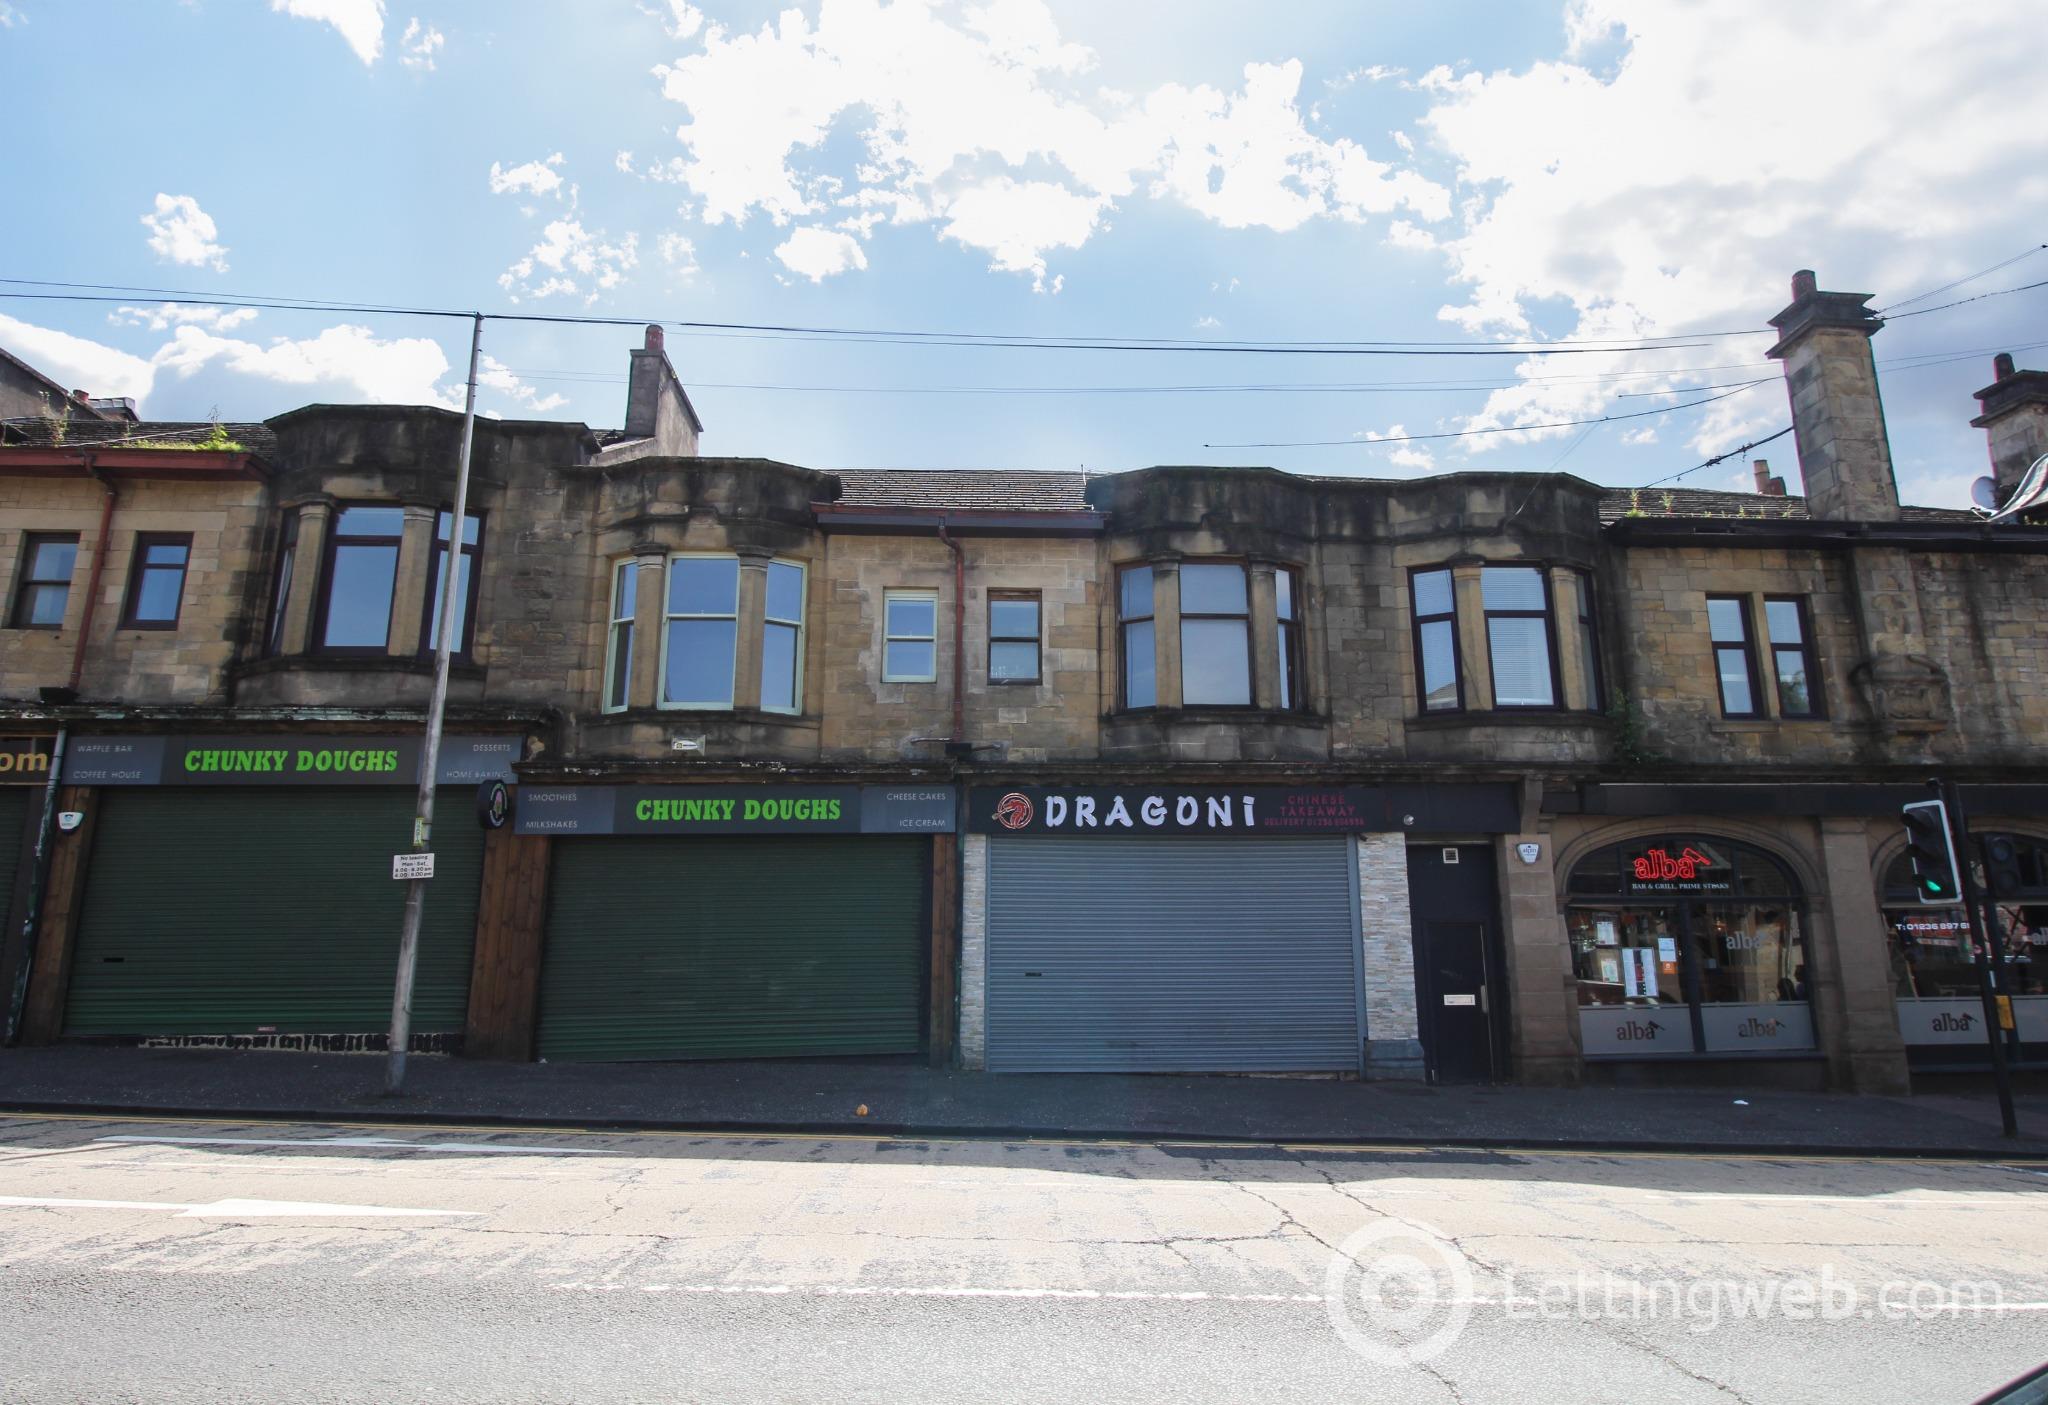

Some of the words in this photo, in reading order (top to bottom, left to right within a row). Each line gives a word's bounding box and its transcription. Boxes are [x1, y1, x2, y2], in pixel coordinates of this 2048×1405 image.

[473, 744, 511, 752] DESSERTS
[184, 750, 288, 771] CHUNKY
[296, 750, 398, 771] DOUGHS
[73, 770, 106, 779] COFFEE
[111, 770, 142, 779] HOUSE
[446, 770, 472, 778] HOME
[474, 770, 508, 778] BAKING
[528, 793, 577, 801] SMOOTHIES
[886, 793, 917, 801] CHEESE
[919, 793, 946, 801] CAKES
[1287, 795, 1345, 805] CHINESE
[636, 799, 735, 820] CHUNKY
[744, 799, 841, 820] DOUGHS
[1280, 806, 1356, 816] TAKEAWAY
[526, 820, 578, 829] MILKSHAKES
[899, 819, 913, 827] ICE
[915, 819, 946, 827] CREAM
[1264, 818, 1304, 826] DELIVERY
[1634, 849, 1695, 879] alba
[1726, 930, 1762, 949] alba
[1932, 1012, 1970, 1031] alba
[1616, 1021, 1656, 1040] alba
[1738, 1018, 1777, 1038] alba
